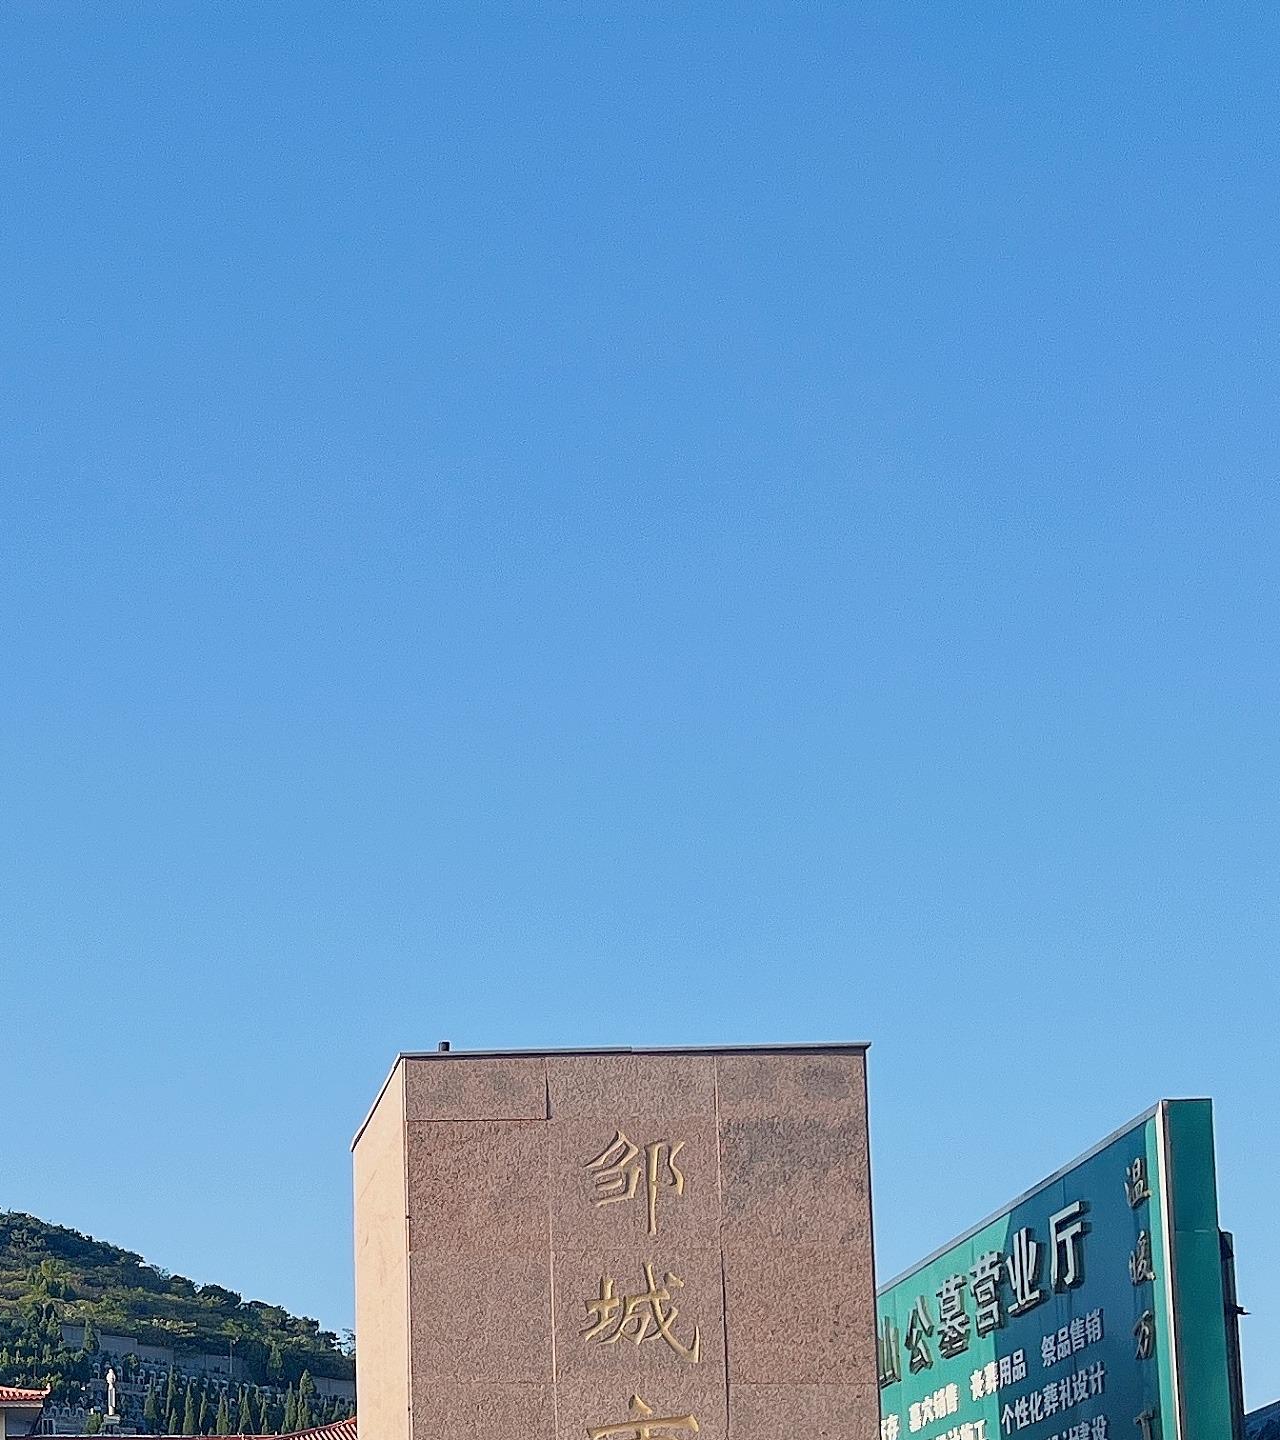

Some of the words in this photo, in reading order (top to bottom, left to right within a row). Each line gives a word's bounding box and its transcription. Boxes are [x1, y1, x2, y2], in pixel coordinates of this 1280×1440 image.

[908, 1382, 959, 1432] 墓穴销售
[969, 1349, 1028, 1401] 丧葬用品
[1001, 1360, 1105, 1435] 个性化葬礼设计
